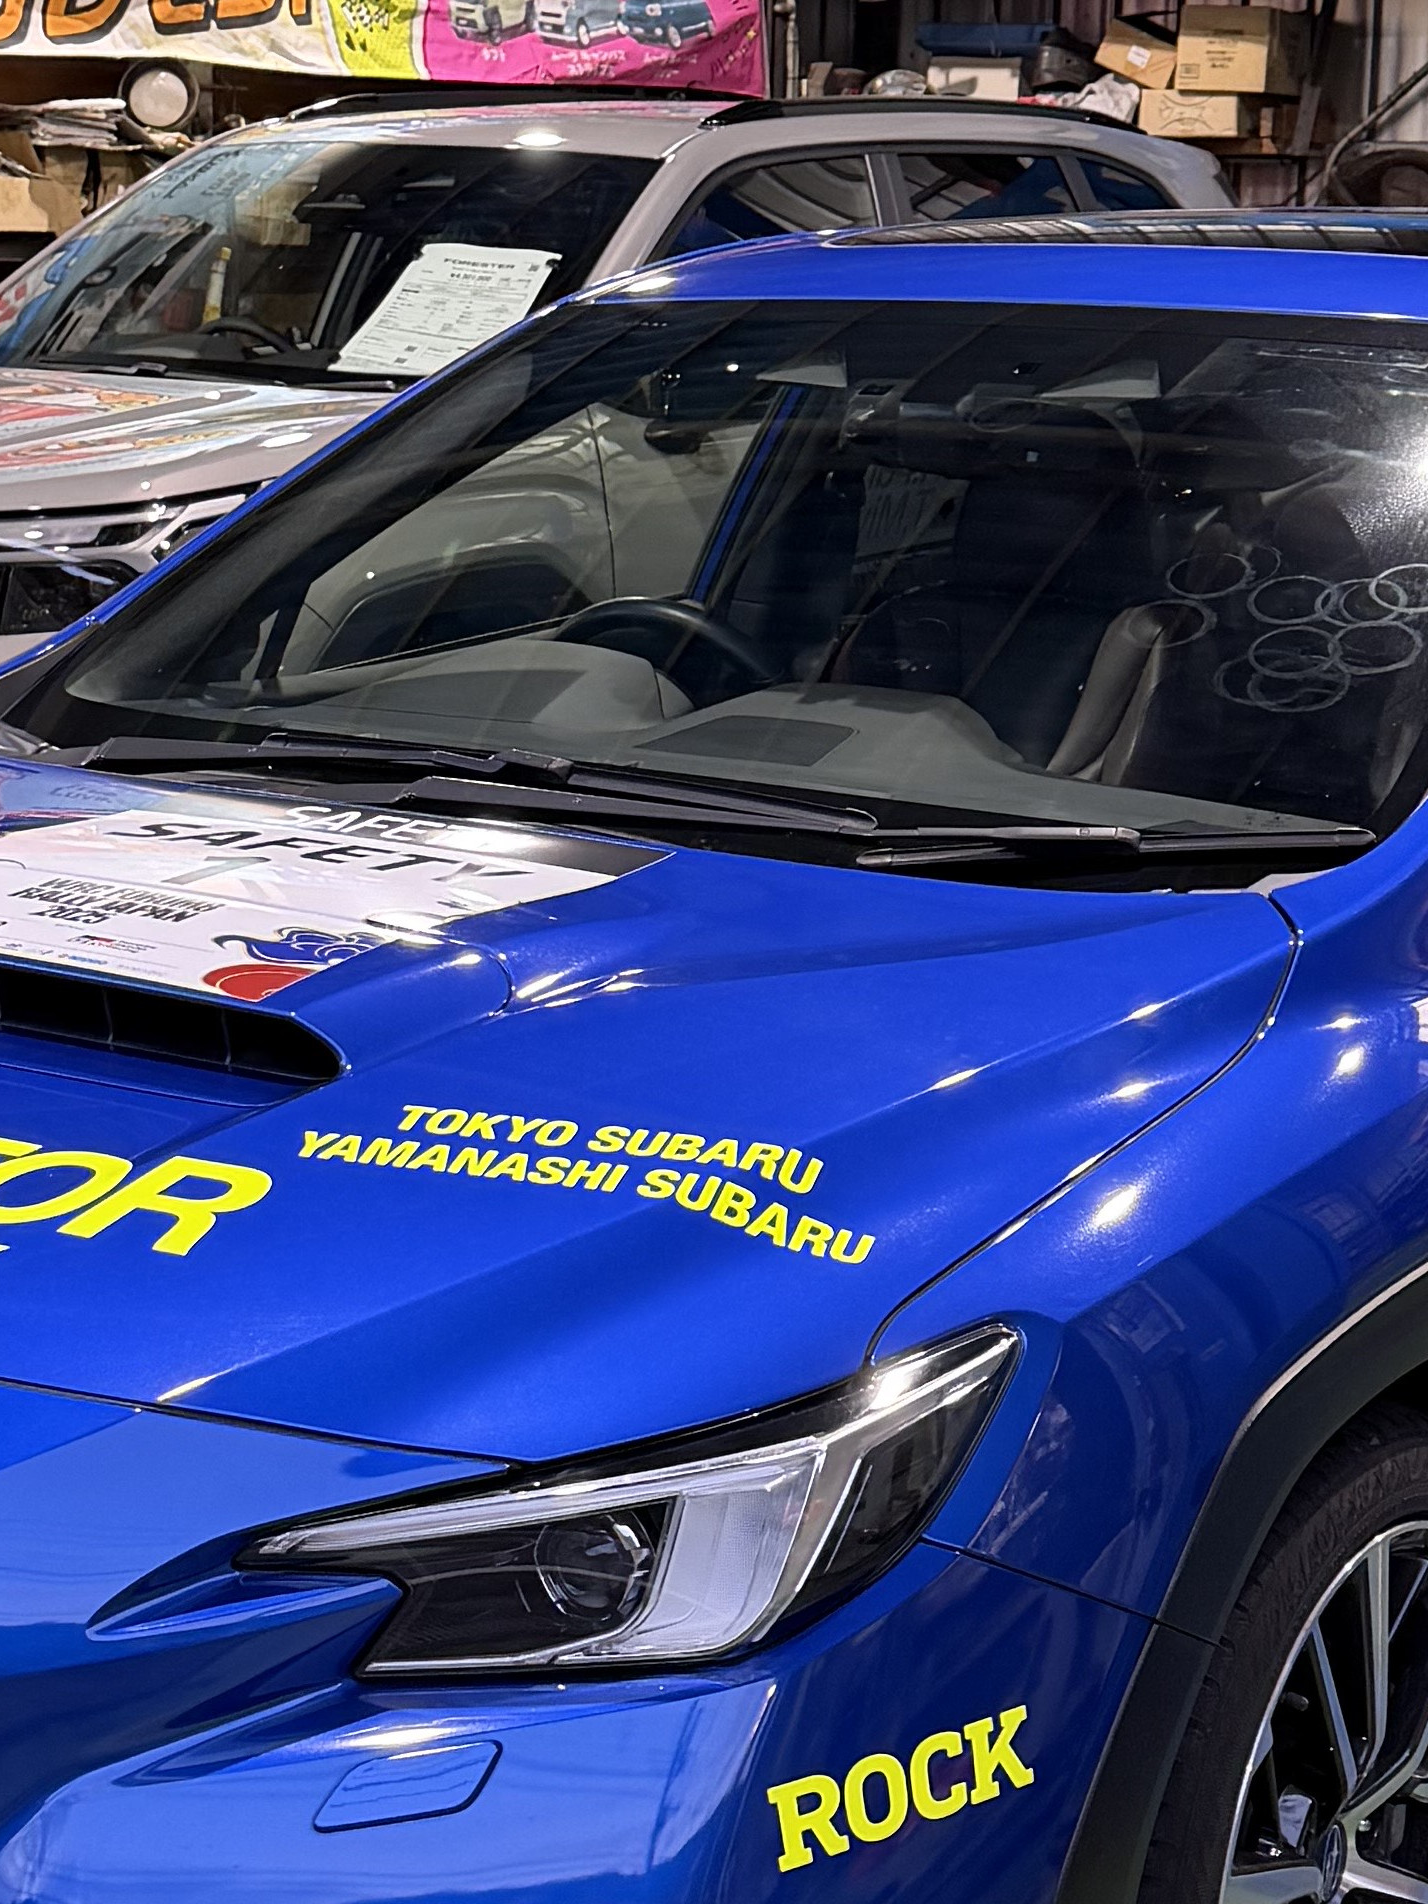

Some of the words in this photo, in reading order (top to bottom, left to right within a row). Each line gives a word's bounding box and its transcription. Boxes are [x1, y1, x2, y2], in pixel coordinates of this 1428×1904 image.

[105, 822, 535, 882] SAFETY
[298, 1130, 624, 1194] YAMANASHI
[635, 1168, 876, 1265] SUBARU
[399, 1104, 578, 1147] TOKYO
[588, 1125, 824, 1195] SUBARU
[767, 1704, 1035, 1873] ROCK
